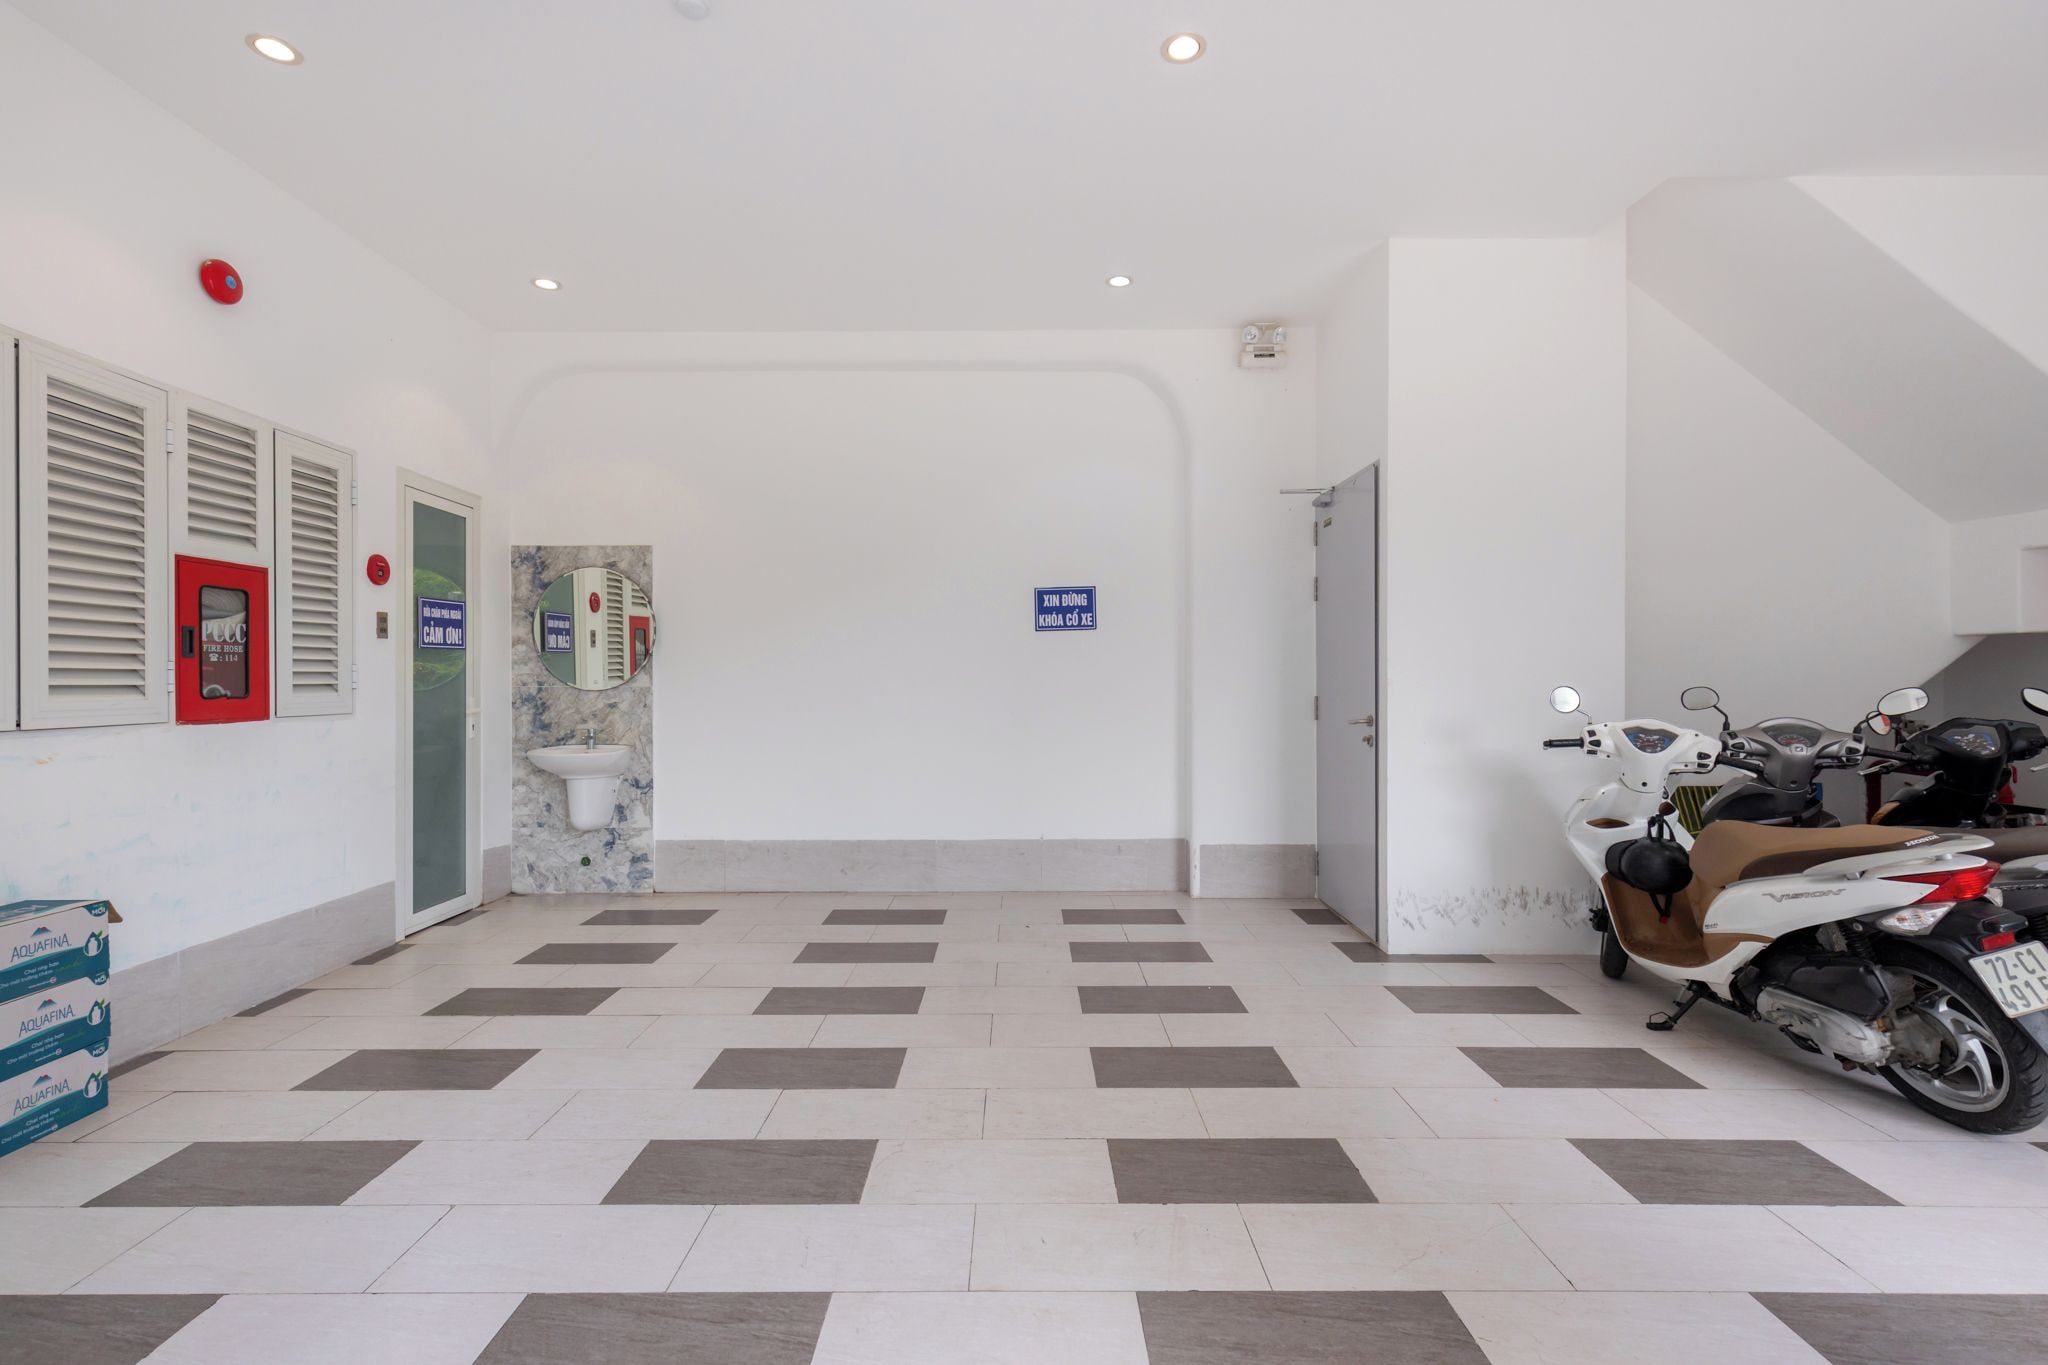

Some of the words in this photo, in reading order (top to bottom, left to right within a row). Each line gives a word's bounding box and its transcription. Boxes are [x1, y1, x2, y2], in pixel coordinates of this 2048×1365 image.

[1043, 594, 1060, 607] XIN
[1039, 611, 1064, 627] KHÓA
[1081, 612, 1093, 626] XE
[202, 623, 247, 643] PCCC
[423, 620, 444, 644] CẢM
[203, 644, 222, 653] FIRE
[224, 644, 244, 653] HOSE
[225, 654, 238, 662] 114
[10, 933, 72, 963] AQUAFINA
[1983, 948, 2046, 983] 72-C1
[19, 1003, 76, 1038] AQUAFINA
[13, 1078, 72, 1116] AQUAFINA
